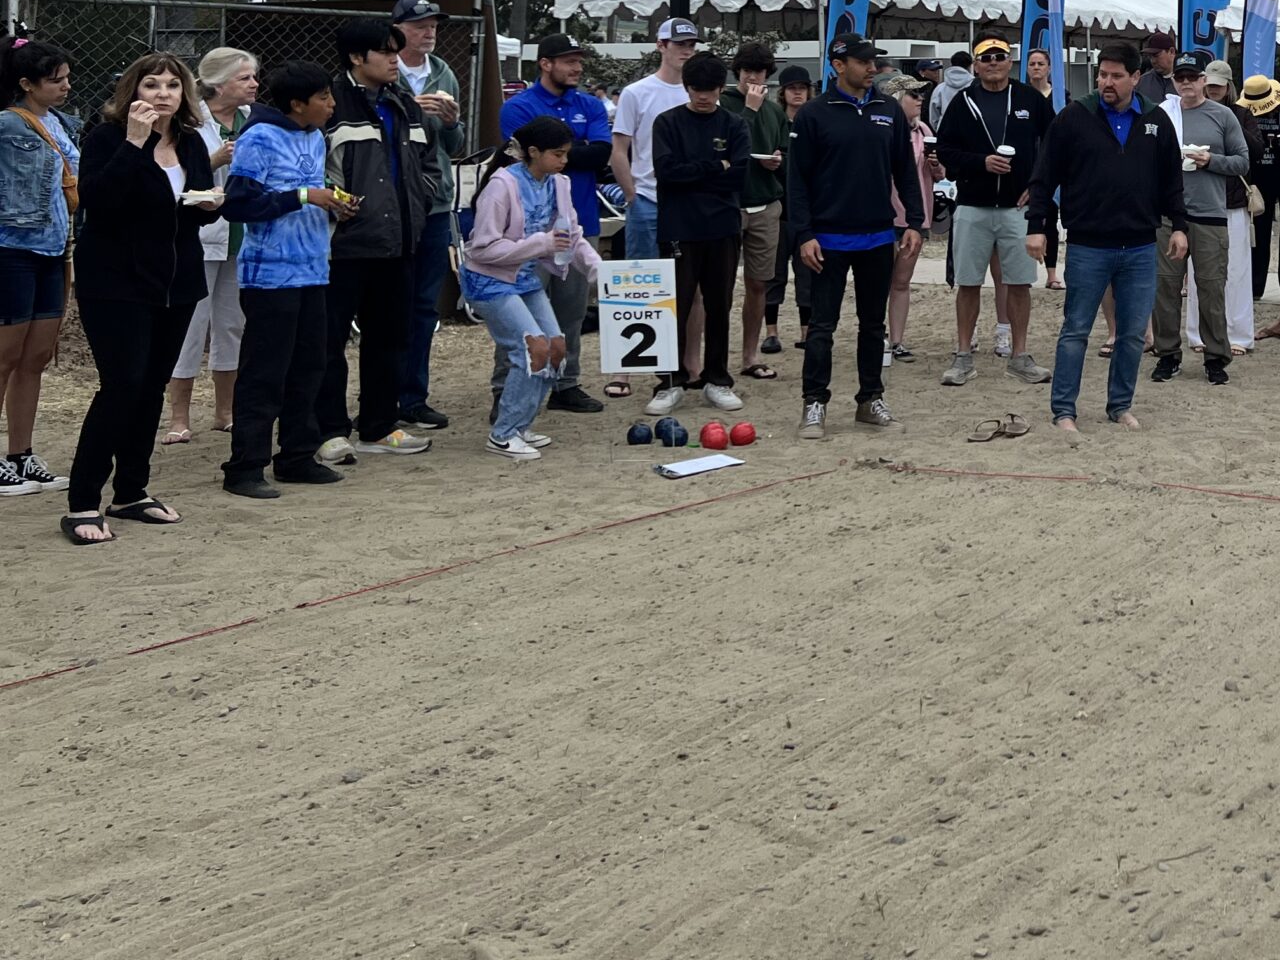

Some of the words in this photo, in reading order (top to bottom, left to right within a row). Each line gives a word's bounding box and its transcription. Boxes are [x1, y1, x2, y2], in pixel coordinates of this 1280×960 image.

[1144, 123, 1159, 138] H
[612, 274, 661, 285] BOCCE
[613, 310, 663, 321] COURT
[620, 323, 658, 368] 2
